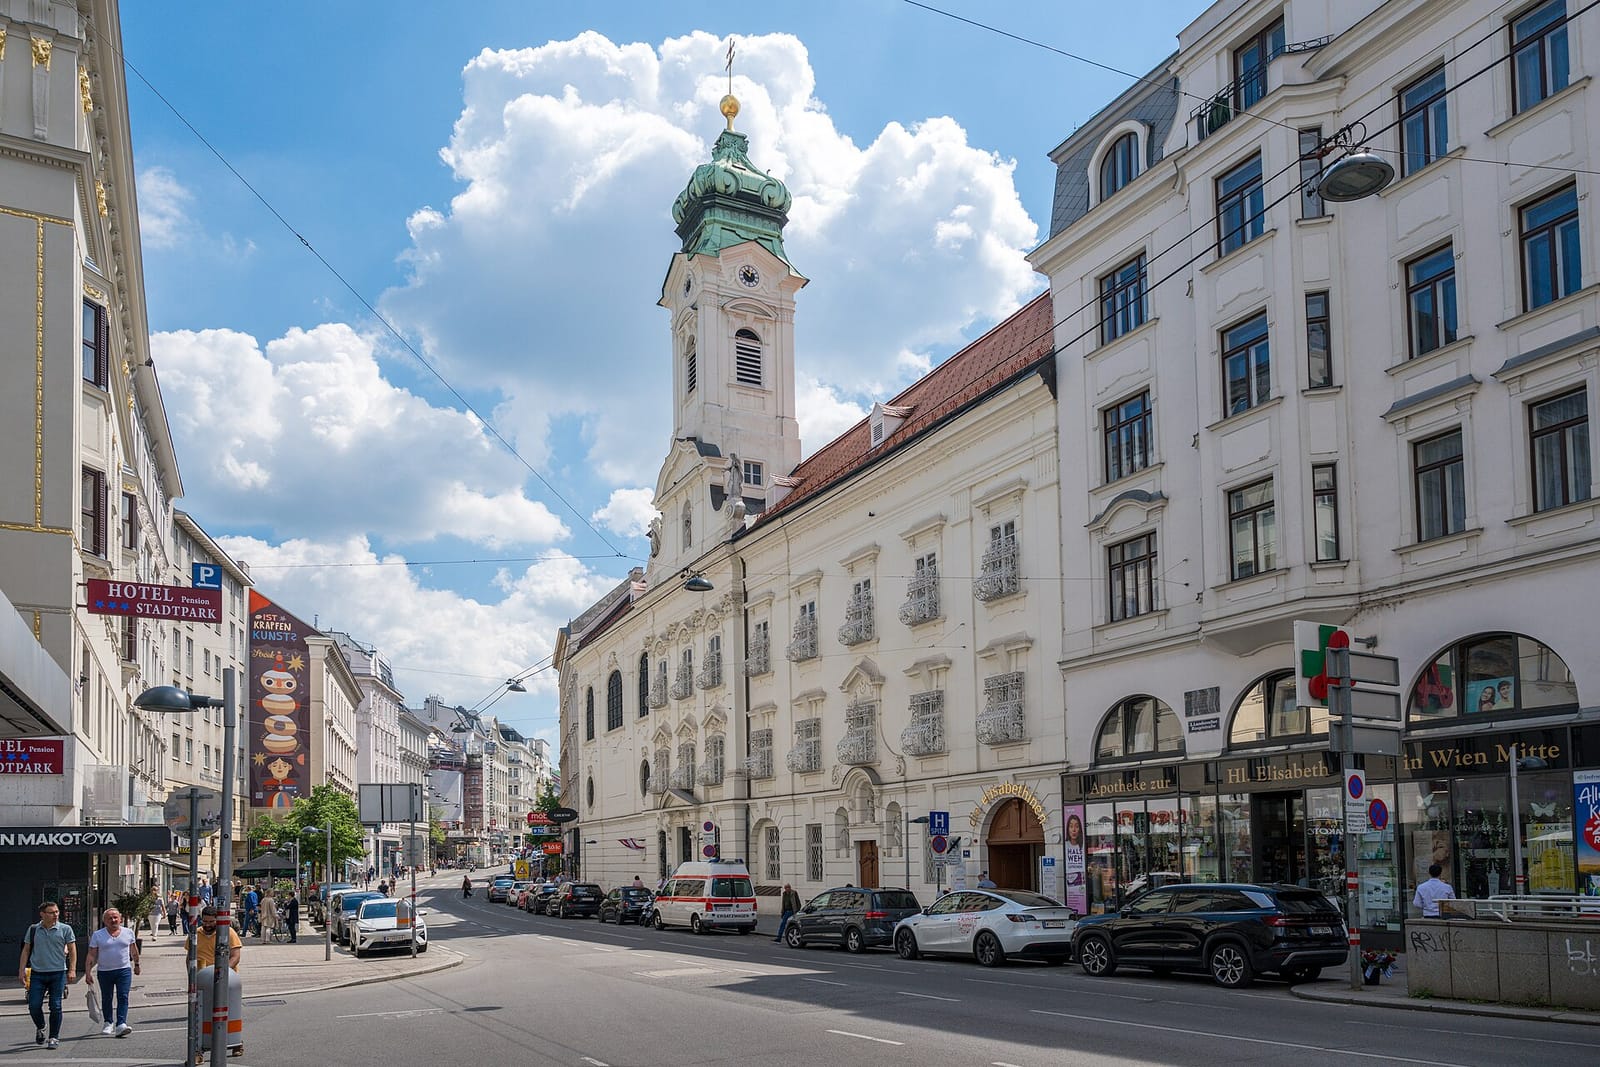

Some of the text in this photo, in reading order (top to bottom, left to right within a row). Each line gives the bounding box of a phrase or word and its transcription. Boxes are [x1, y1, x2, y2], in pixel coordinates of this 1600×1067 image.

[200, 567, 214, 584] P
[108, 582, 210, 605] HOTEL Pension
[136, 602, 217, 619] STADTPARK
[253, 621, 292, 631] KRAPFEN
[29, 745, 55, 753] Pension
[1090, 742, 1561, 795] Apotheke zur Hl. Elisabeth in Wien Mitte
[935, 813, 944, 828] H
[930, 827, 949, 835] SPITAL
[1067, 854, 1083, 863] WEH
